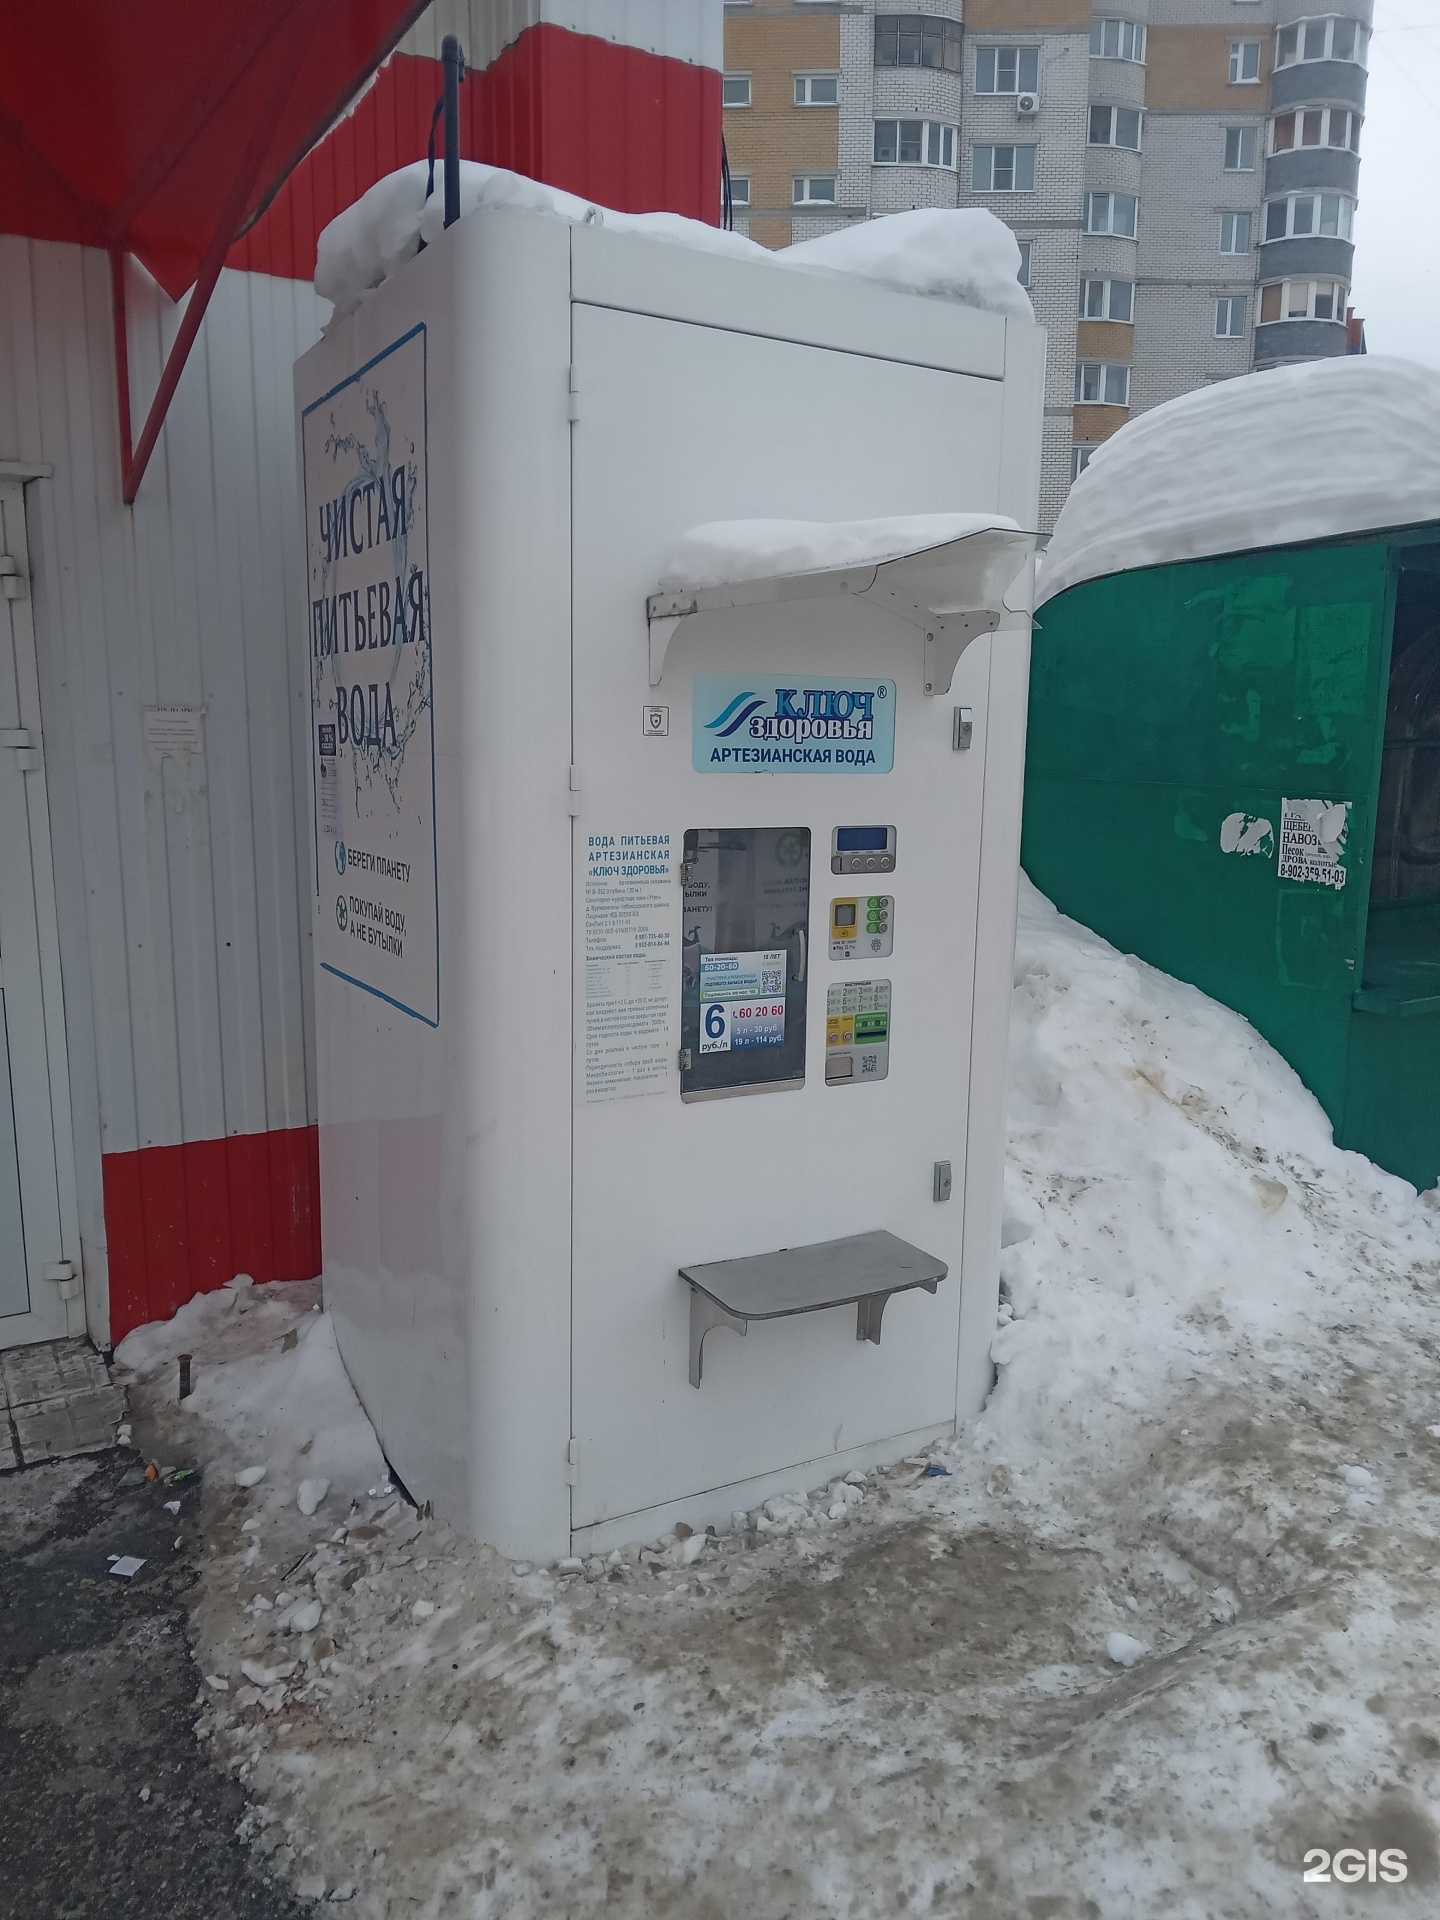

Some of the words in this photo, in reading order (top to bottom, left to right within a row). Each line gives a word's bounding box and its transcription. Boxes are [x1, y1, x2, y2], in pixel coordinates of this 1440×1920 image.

[318, 464, 408, 563] ЧИСТАЯ
[312, 570, 426, 658] ПИТЬЕВАЯ
[335, 681, 398, 758] ВОДА
[775, 688, 875, 721] КЛЮЧ
[710, 747, 832, 764] АРТЕЗИАНСКАЯ
[835, 749, 876, 765] ВОДА
[588, 836, 615, 849] ВОДА
[620, 834, 670, 847] ПИТЬЕВАЯ
[1281, 831, 1318, 846] НАВОЗ
[1281, 843, 1305, 857] Песок
[347, 848, 376, 872] БЕРЕГИ
[376, 857, 411, 884] ПЛАНЕТУ
[588, 849, 671, 862] АРТЕЗИАНСКАЯ
[349, 896, 384, 924] ПОКУПАЙ
[385, 908, 407, 936] ВОДУ,
[350, 921, 356, 936] А
[356, 924, 367, 942] НЕ
[367, 927, 403, 958] БУТЫЛКИ
[704, 1003, 726, 1039] 6
[739, 1007, 752, 1019] 60
[755, 1006, 768, 1018] 20
[771, 1004, 784, 1016] 60
[755, 1035, 767, 1044] 114
